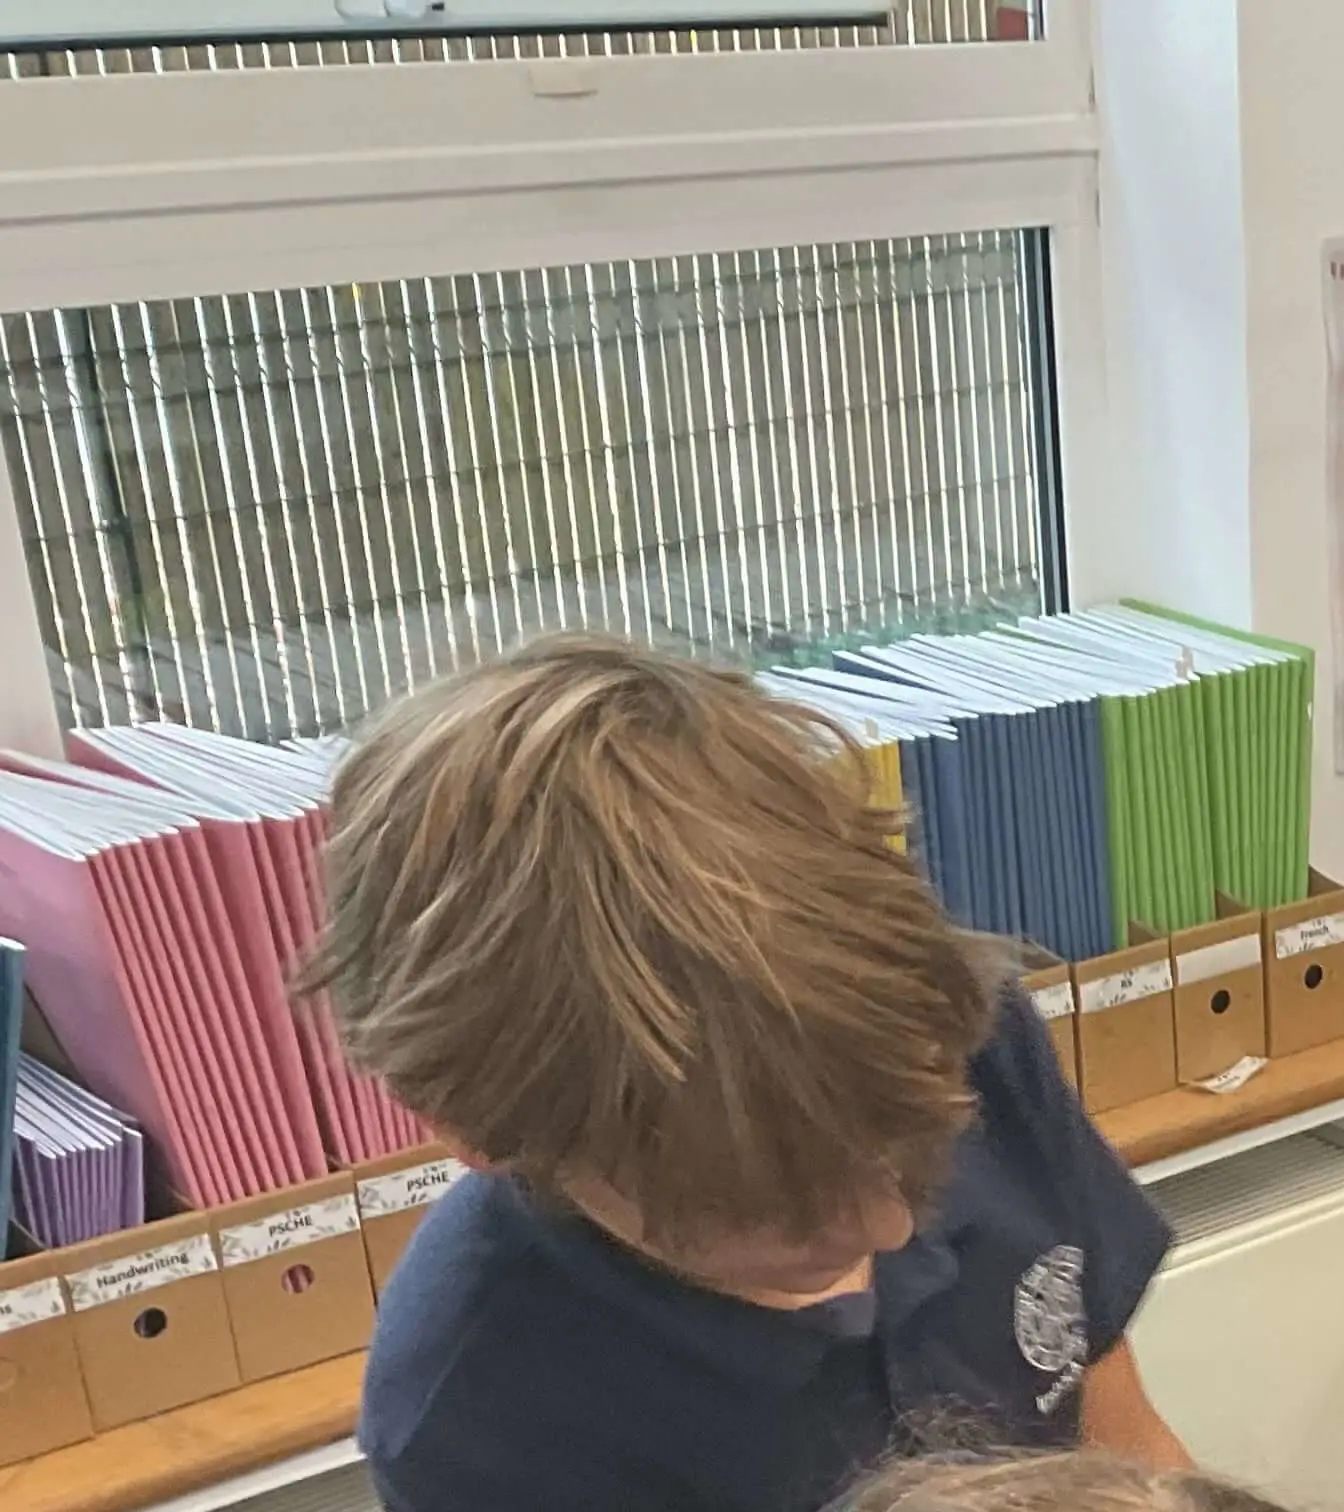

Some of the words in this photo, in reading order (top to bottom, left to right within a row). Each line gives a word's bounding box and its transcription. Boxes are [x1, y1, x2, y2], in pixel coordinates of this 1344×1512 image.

[1300, 925, 1329, 941] French
[407, 1172, 450, 1192] PSCHE
[268, 1215, 314, 1236] PSCHE
[96, 1252, 190, 1288] Handwriting
